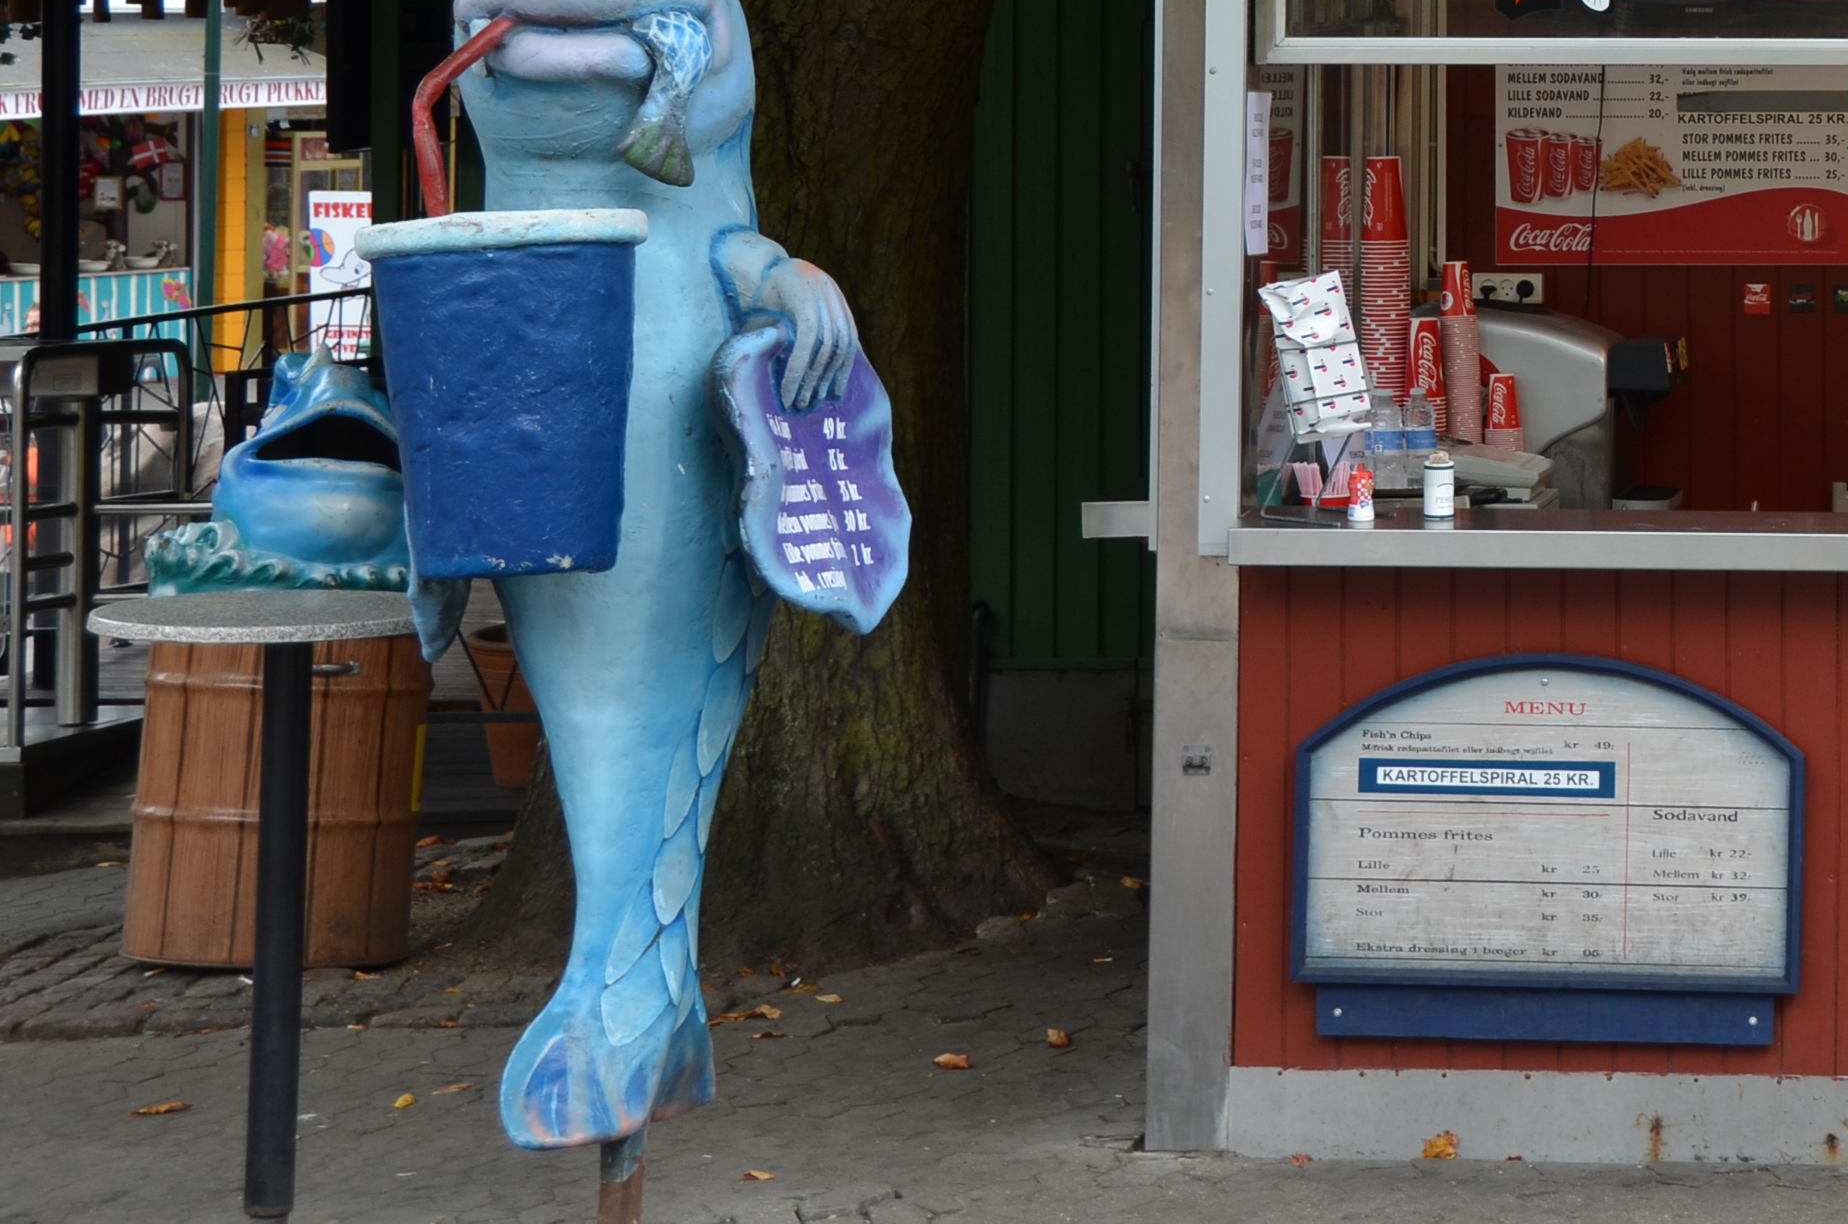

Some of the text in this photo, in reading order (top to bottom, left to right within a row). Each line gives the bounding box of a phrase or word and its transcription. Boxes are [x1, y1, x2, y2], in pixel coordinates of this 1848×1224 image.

[1507, 73, 1669, 85] MELLEM SODAVAND 32,-
[121, 86, 140, 109] EN
[146, 84, 204, 107] BRUGT
[1507, 90, 1669, 103] LILLE SODAVAND 22,-
[1507, 107, 1669, 120] KILDEVAND 20,-
[1677, 113, 1848, 125] KARTOFFELSPIRAL 25 KR.
[1682, 133, 1845, 147] STOR POMMES FRITES 35,-
[1682, 151, 1845, 164] MELLEM POMMES FRITES 30,-
[1517, 144, 1535, 198] Coca-Cola
[1549, 145, 1566, 193] Coca-Cola
[1682, 168, 1845, 181] LILLE POMMES FRITES 25,-
[1509, 222, 1597, 252] Coca-Cola
[1418, 331, 1437, 393] Coca-Cola
[1492, 382, 1508, 426] Coca-Cola
[823, 417, 834, 440] 49
[1504, 700, 1587, 716] MENU
[1362, 729, 1432, 741] Fish'n Chips
[1462, 745, 1483, 753] eller
[1564, 740, 1579, 749] kr
[1382, 769, 1594, 787] KARTOFFELSPIRAL 25 KR.
[1653, 809, 1738, 822] Sodavand
[1359, 827, 1493, 841] Pommes frites
[1652, 848, 1723, 858] Lille kr
[1358, 860, 1390, 870] Lille
[1541, 864, 1558, 874] kr
[1653, 869, 1723, 880] Mellem kr
[1357, 884, 1557, 898] Mellem kr
[1653, 892, 1723, 902] Stor kr
[1356, 907, 1557, 922] Stor kr
[1356, 942, 1403, 953] Ekstra
[1408, 944, 1467, 956] dressing
[1542, 948, 1558, 957] kr
